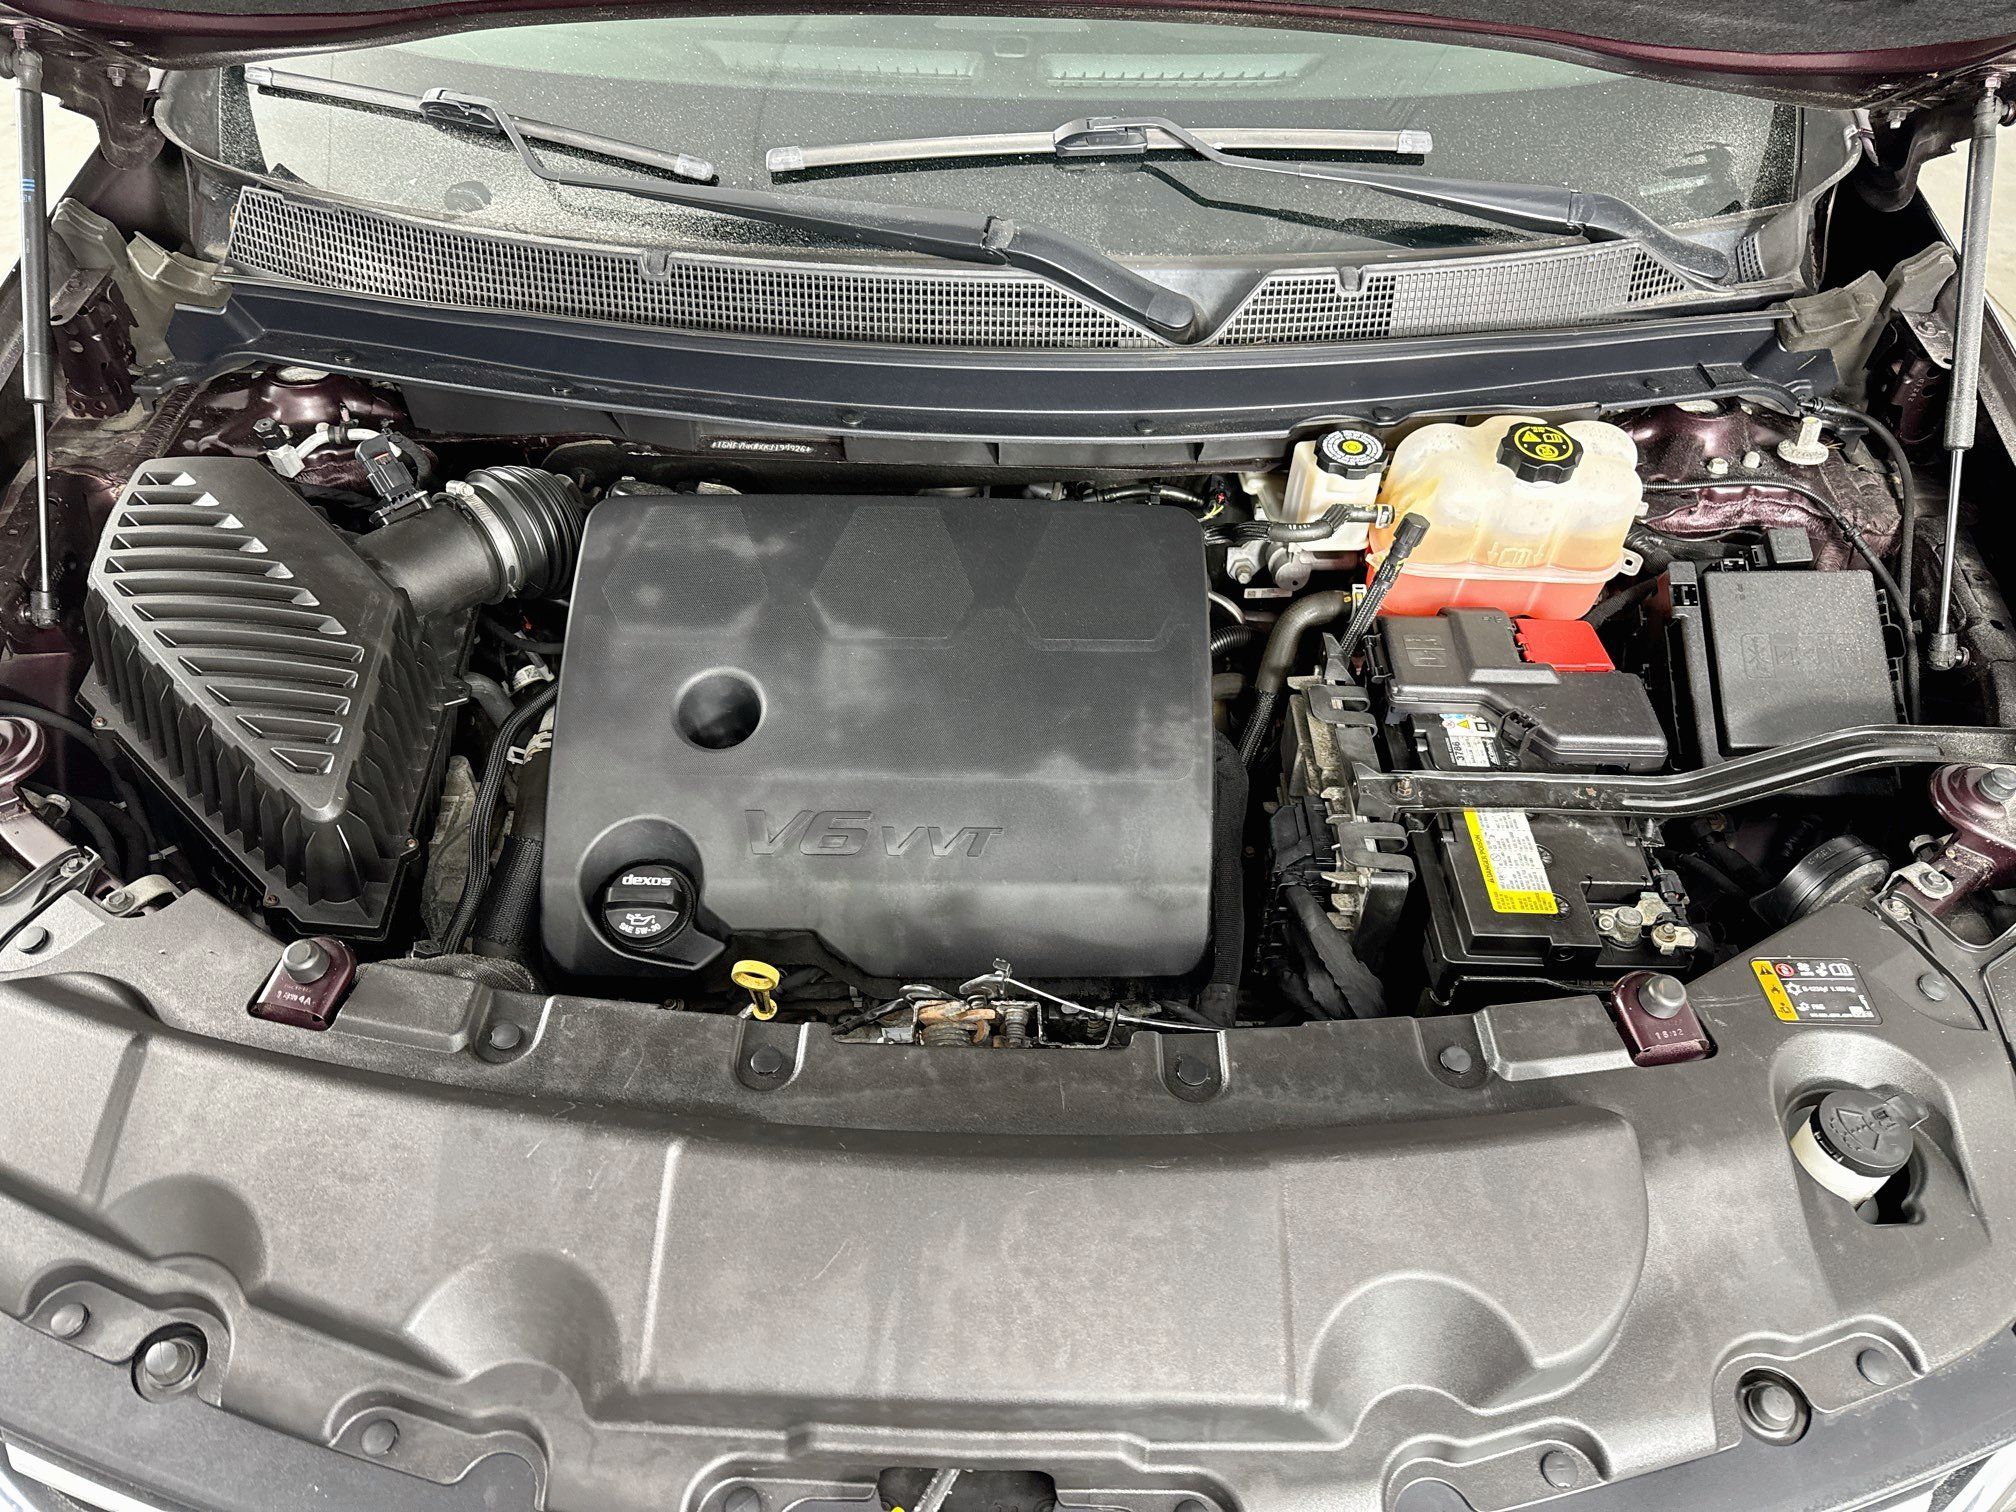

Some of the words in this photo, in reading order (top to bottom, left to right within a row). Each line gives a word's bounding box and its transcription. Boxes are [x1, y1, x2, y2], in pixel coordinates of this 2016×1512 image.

[1453, 741, 1465, 761] 3786
[745, 809, 872, 856] V6
[881, 826, 1004, 858] VVT
[621, 874, 673, 886] dexos
[618, 922, 634, 934] SAE
[635, 923, 661, 935] 5W-30
